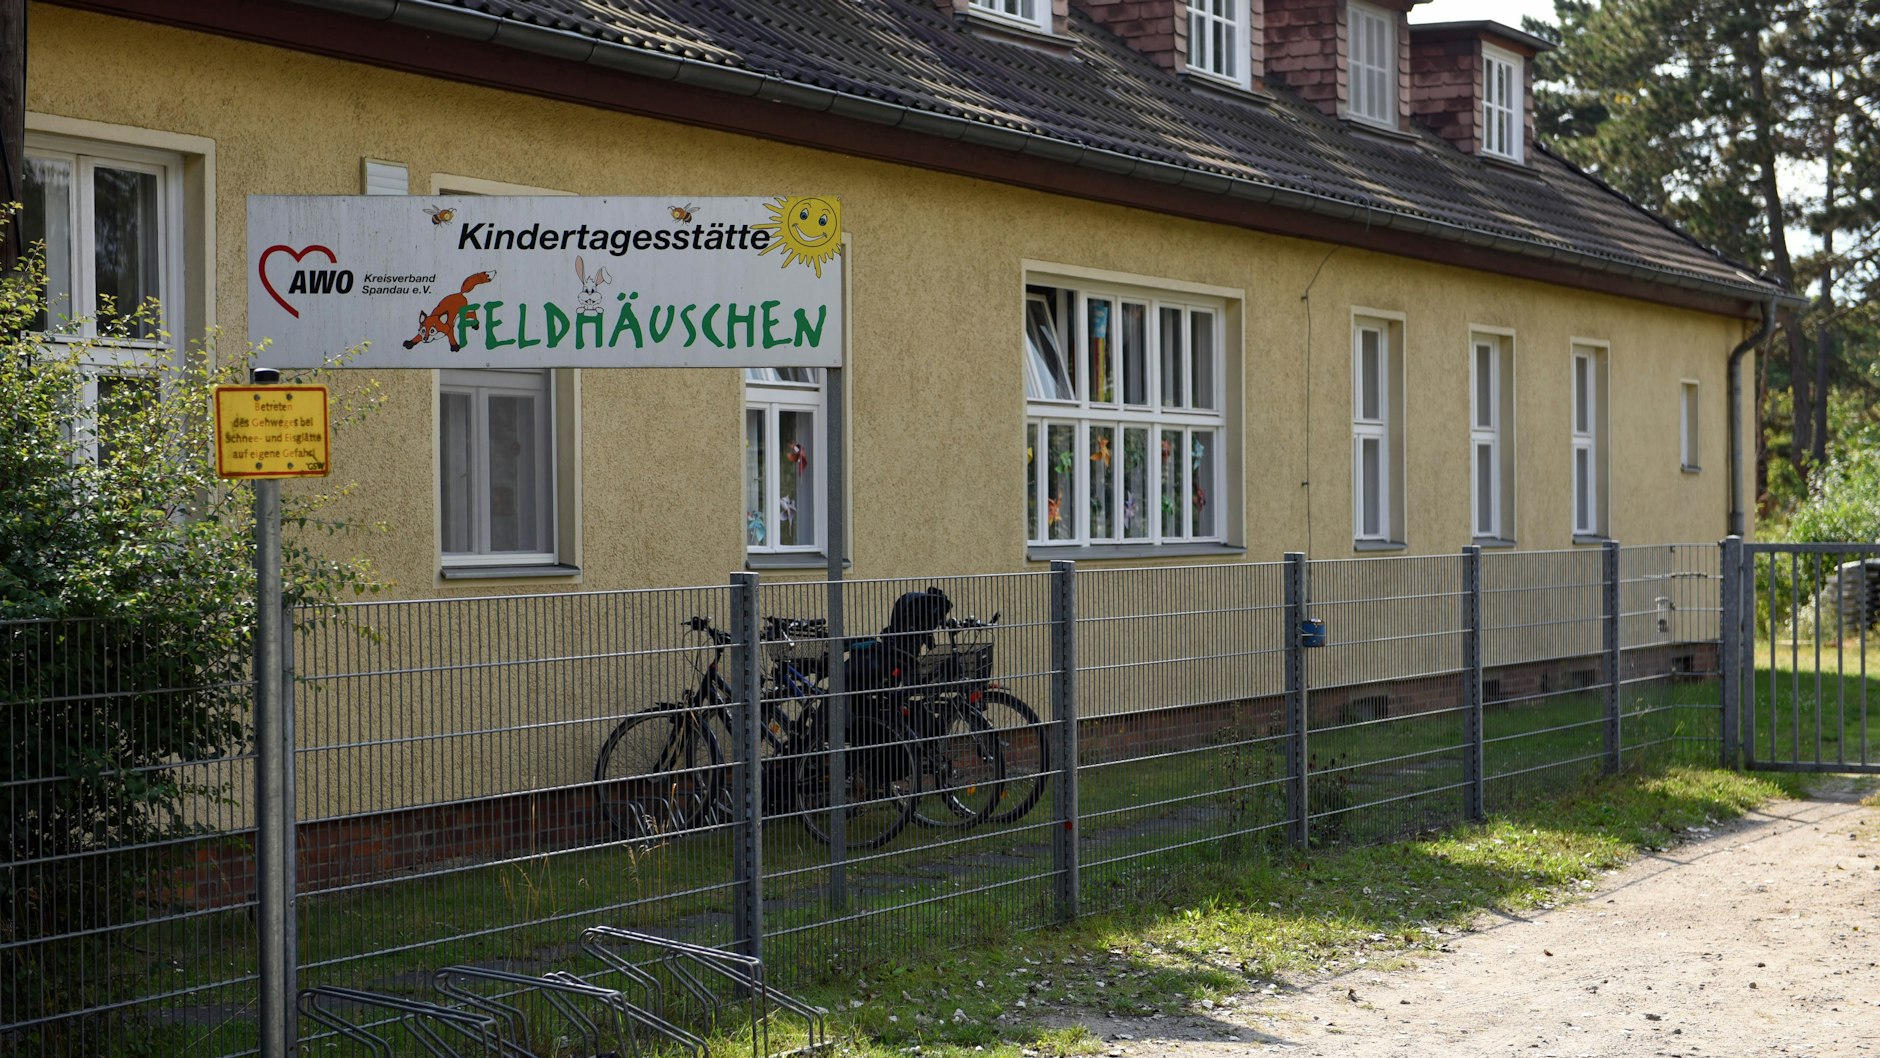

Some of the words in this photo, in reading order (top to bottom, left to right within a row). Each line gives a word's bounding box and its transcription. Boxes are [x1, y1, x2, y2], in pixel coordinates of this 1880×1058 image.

[458, 223, 770, 256] Kindertagesstätte
[288, 270, 354, 294] AWO
[364, 274, 436, 283] Kreisverband
[362, 286, 409, 295] Spandau
[412, 286, 431, 295] e.V.
[456, 292, 827, 349] FELDHÄUSCHEN
[255, 403, 292, 411] Betreten
[300, 417, 313, 427] bei
[265, 434, 282, 442] und
[233, 449, 248, 458] auf
[250, 451, 280, 460] eigene
